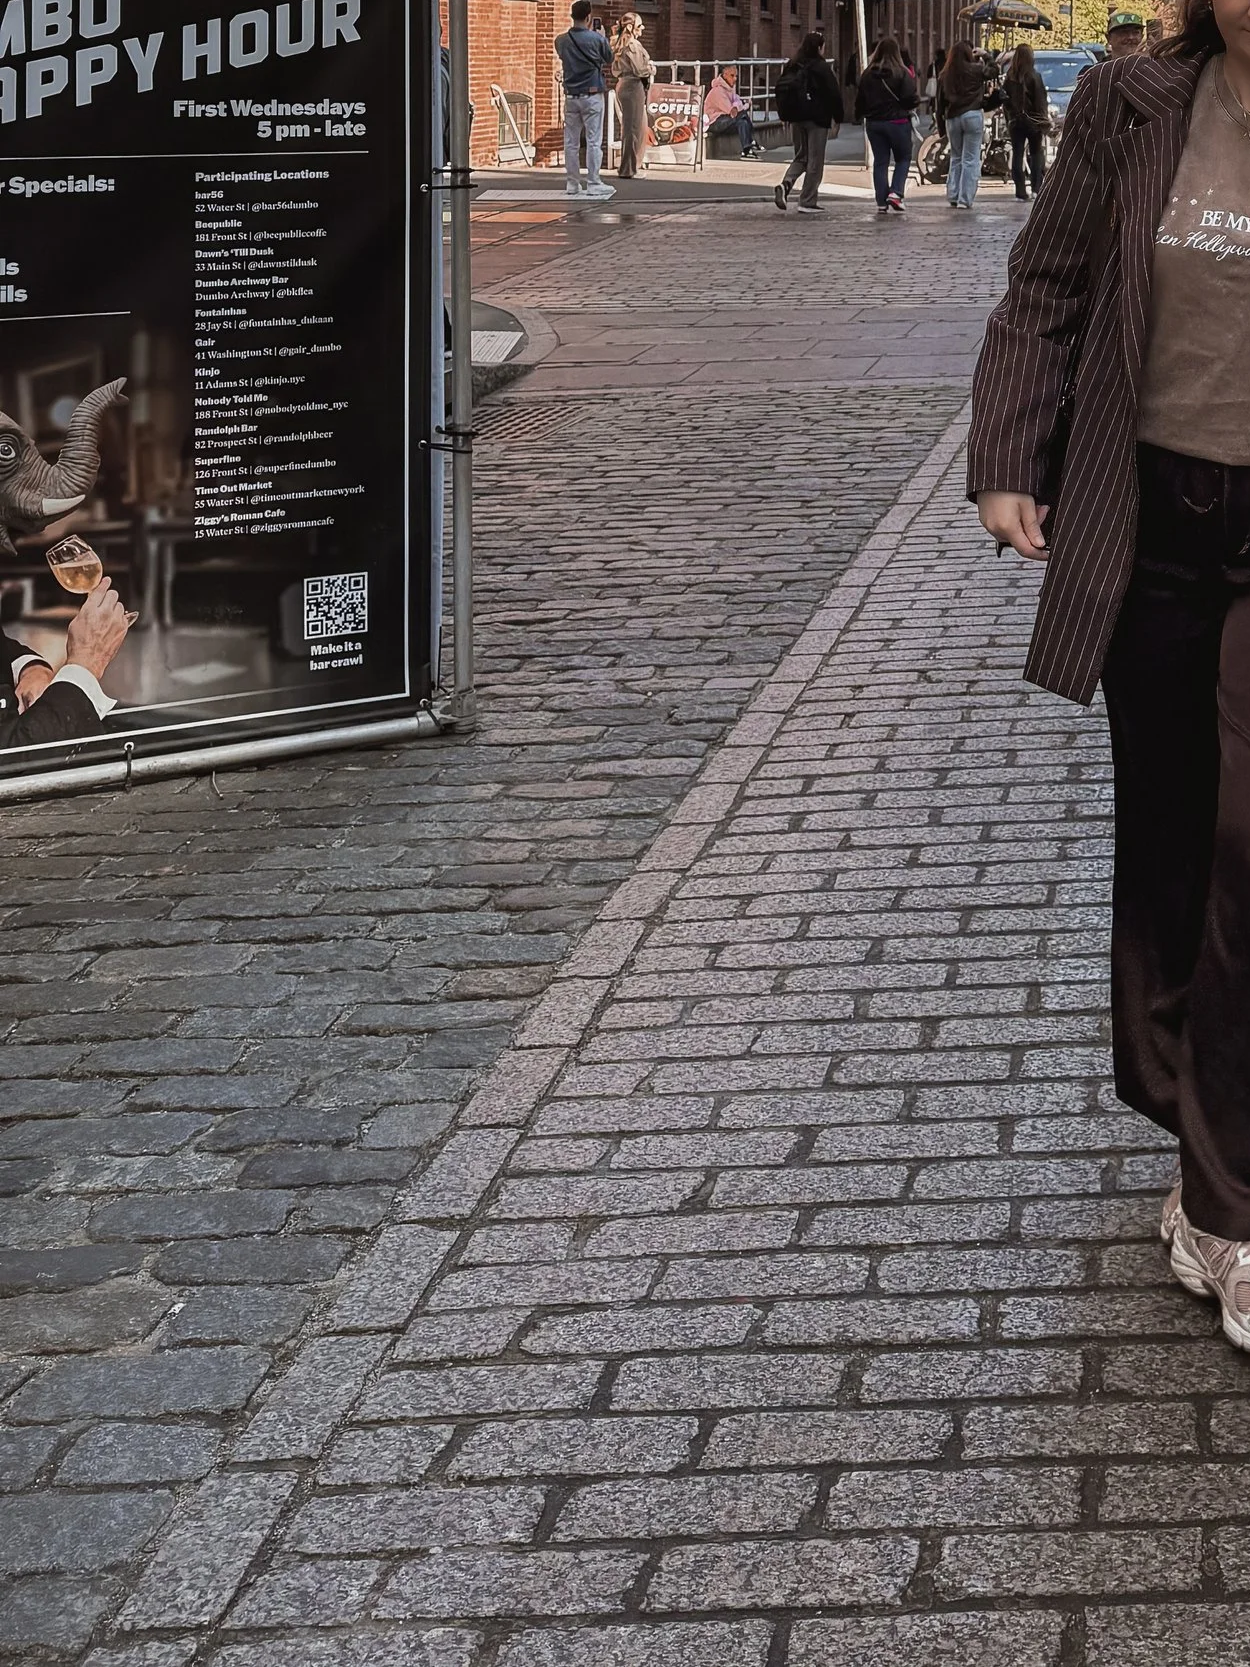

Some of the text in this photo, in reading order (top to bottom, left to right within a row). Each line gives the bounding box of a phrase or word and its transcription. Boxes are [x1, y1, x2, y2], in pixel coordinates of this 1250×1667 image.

[173, 98, 366, 119] First Wednesdays
[649, 102, 700, 115] COFFEE
[257, 121, 272, 138] 5
[275, 123, 310, 141] pm
[325, 119, 366, 137] late
[195, 169, 329, 183] Participating Locations
[9, 174, 115, 198] Specials:
[195, 191, 224, 199] bar56
[195, 204, 205, 212] 52
[207, 204, 235, 212] Water
[236, 203, 245, 211] St
[251, 201, 319, 212] @bar56dumbo
[1200, 210, 1224, 227] BE
[195, 234, 210, 242] 181
[211, 233, 236, 241] Front
[237, 232, 247, 240] St
[250, 247, 274, 256] Dusk
[195, 263, 205, 271] 33
[207, 262, 230, 271] Main
[232, 262, 241, 270] St
[247, 258, 317, 270] @dawnstildusk
[195, 276, 289, 288] Dumbo Archway Bar
[195, 291, 229, 301] Dumbo
[231, 290, 270, 300] Archway
[195, 308, 247, 317] Fontainhas
[195, 322, 206, 330] 28
[206, 321, 221, 332] Jay
[222, 320, 232, 329] St
[195, 338, 216, 347] Gair
[195, 352, 206, 360] 41
[208, 349, 262, 360] Washington
[263, 348, 273, 356] St
[278, 343, 342, 357] @gair_dumbo
[195, 368, 220, 377] Kinjo
[195, 382, 204, 390] 11
[205, 380, 237, 389] Adams
[239, 379, 249, 387] St
[254, 375, 305, 388] @kinjo.nyc
[195, 394, 268, 407] Nobody Told Me
[195, 411, 211, 419] 188
[212, 409, 237, 418] Front
[239, 408, 249, 417] St
[254, 400, 348, 417] @nobodytoldme_nyc
[195, 424, 258, 437] Randolph Bar
[195, 441, 206, 449] 82
[207, 438, 247, 450] Prospect
[248, 436, 258, 445] St
[264, 431, 333, 446] @randolphbeer
[195, 455, 241, 466] Superfine
[195, 470, 211, 479] 126
[212, 468, 237, 478] Front
[238, 467, 247, 476] St
[254, 459, 336, 476] @superfinedumbo
[195, 482, 272, 496] Time Out Market
[195, 501, 205, 509] 55
[206, 499, 234, 508] Water
[235, 497, 244, 506] St
[250, 485, 365, 505] @timeoutmarketnewyork
[230, 511, 263, 522] Roman
[264, 509, 286, 518] Cafe
[195, 530, 204, 539] 15
[206, 528, 233, 537] Water
[234, 526, 244, 535] St
[250, 517, 334, 535] @ziggysromancafe
[311, 641, 362, 656] Make it a
[310, 654, 363, 671] bar crawl
